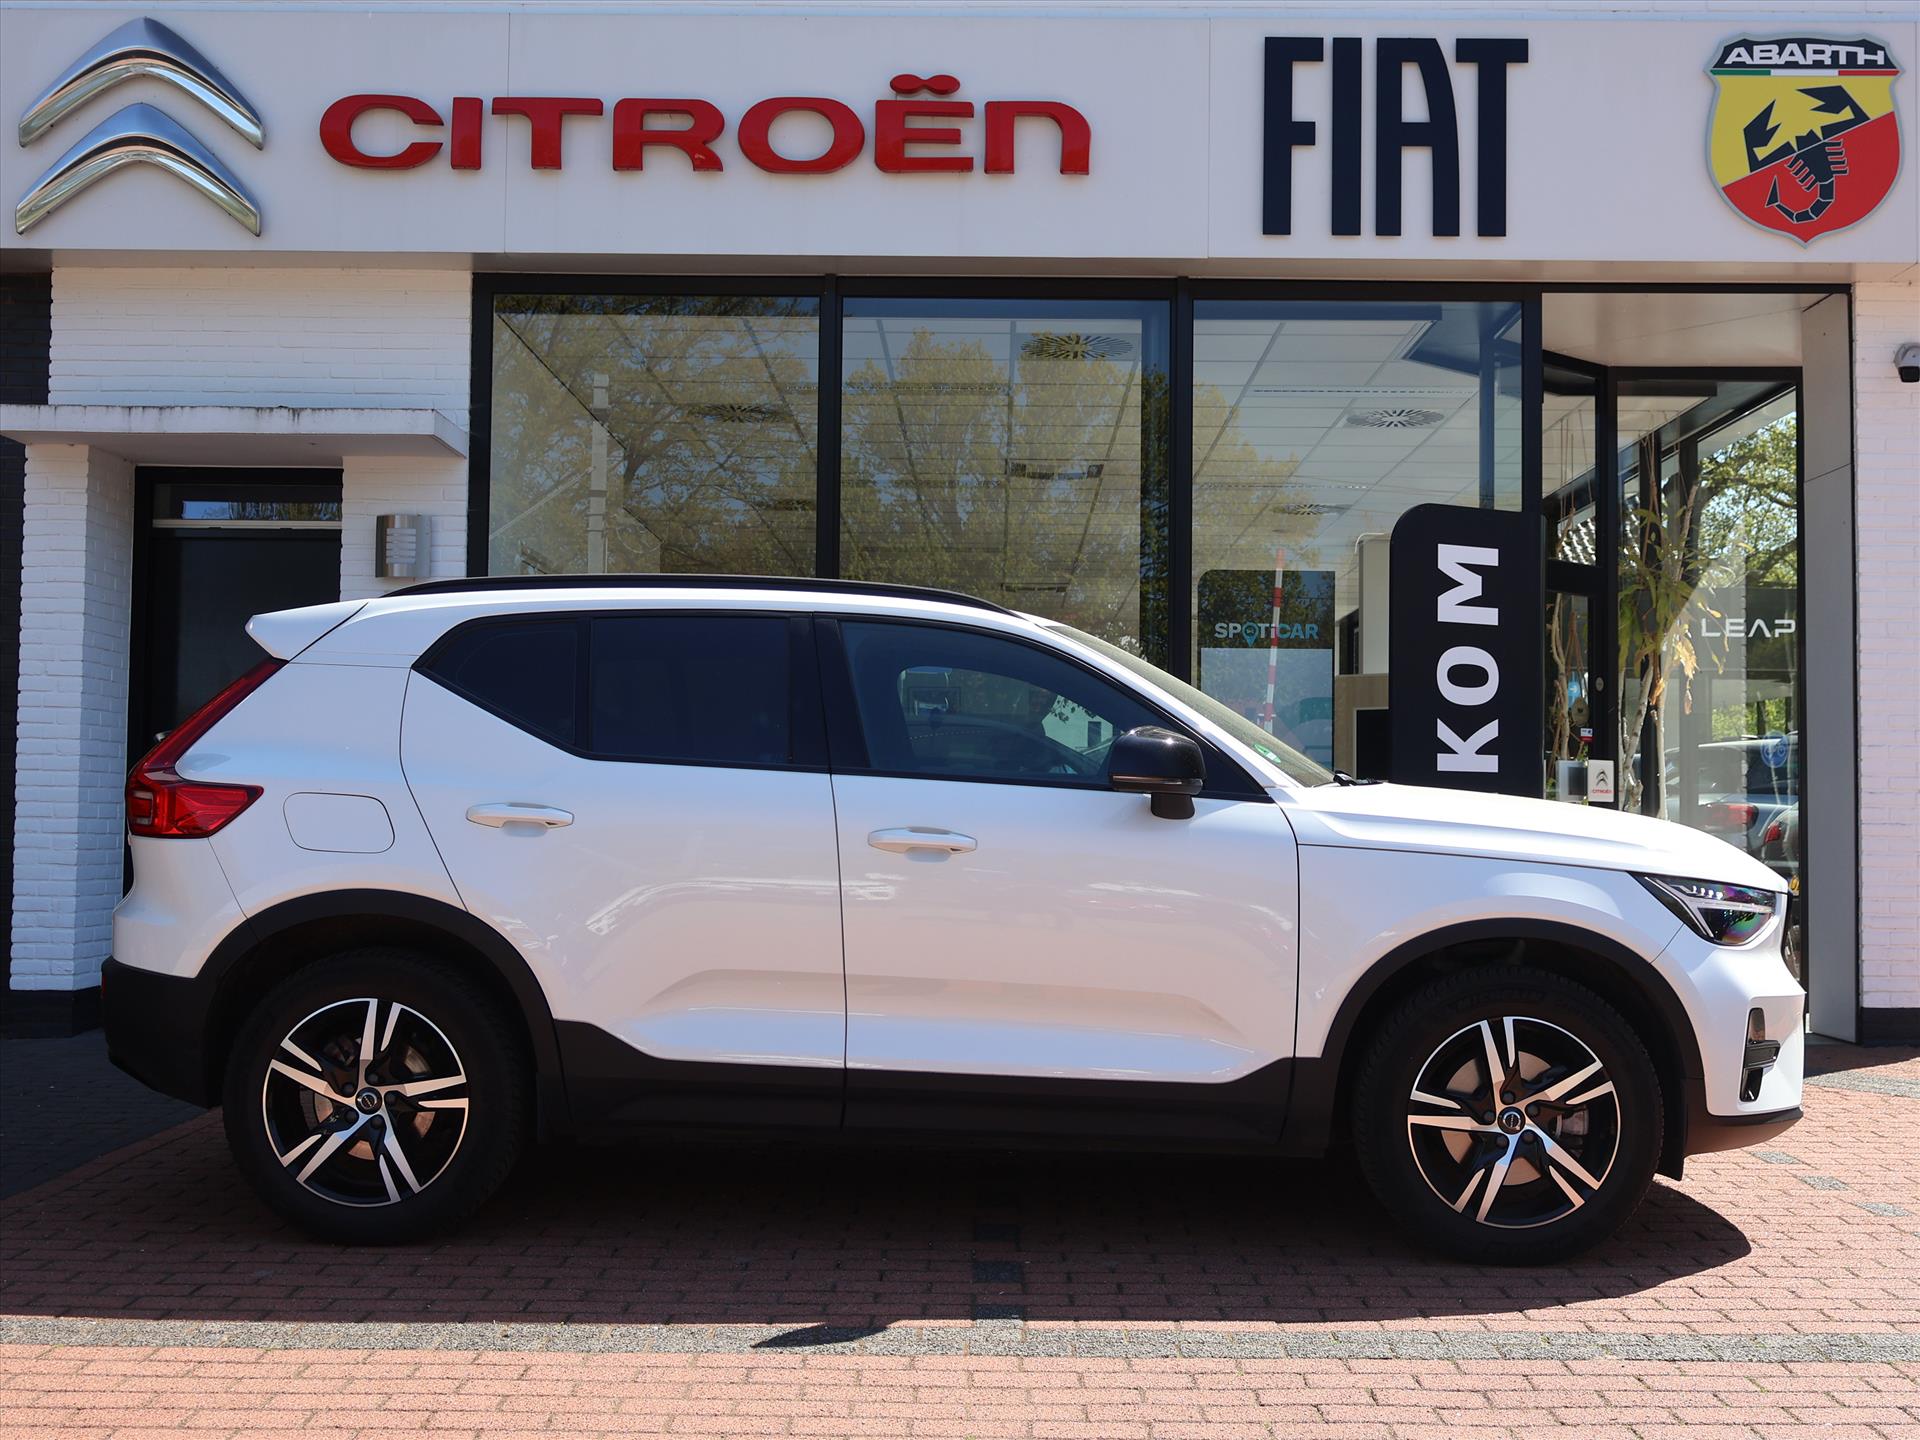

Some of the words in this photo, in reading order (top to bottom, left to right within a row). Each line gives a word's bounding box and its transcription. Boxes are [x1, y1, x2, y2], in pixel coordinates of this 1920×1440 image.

[319, 74, 1091, 175] CITROËN
[1723, 43, 1886, 67] ABARTH
[1263, 37, 1529, 237] FIAT
[1436, 543, 1500, 773] KOM
